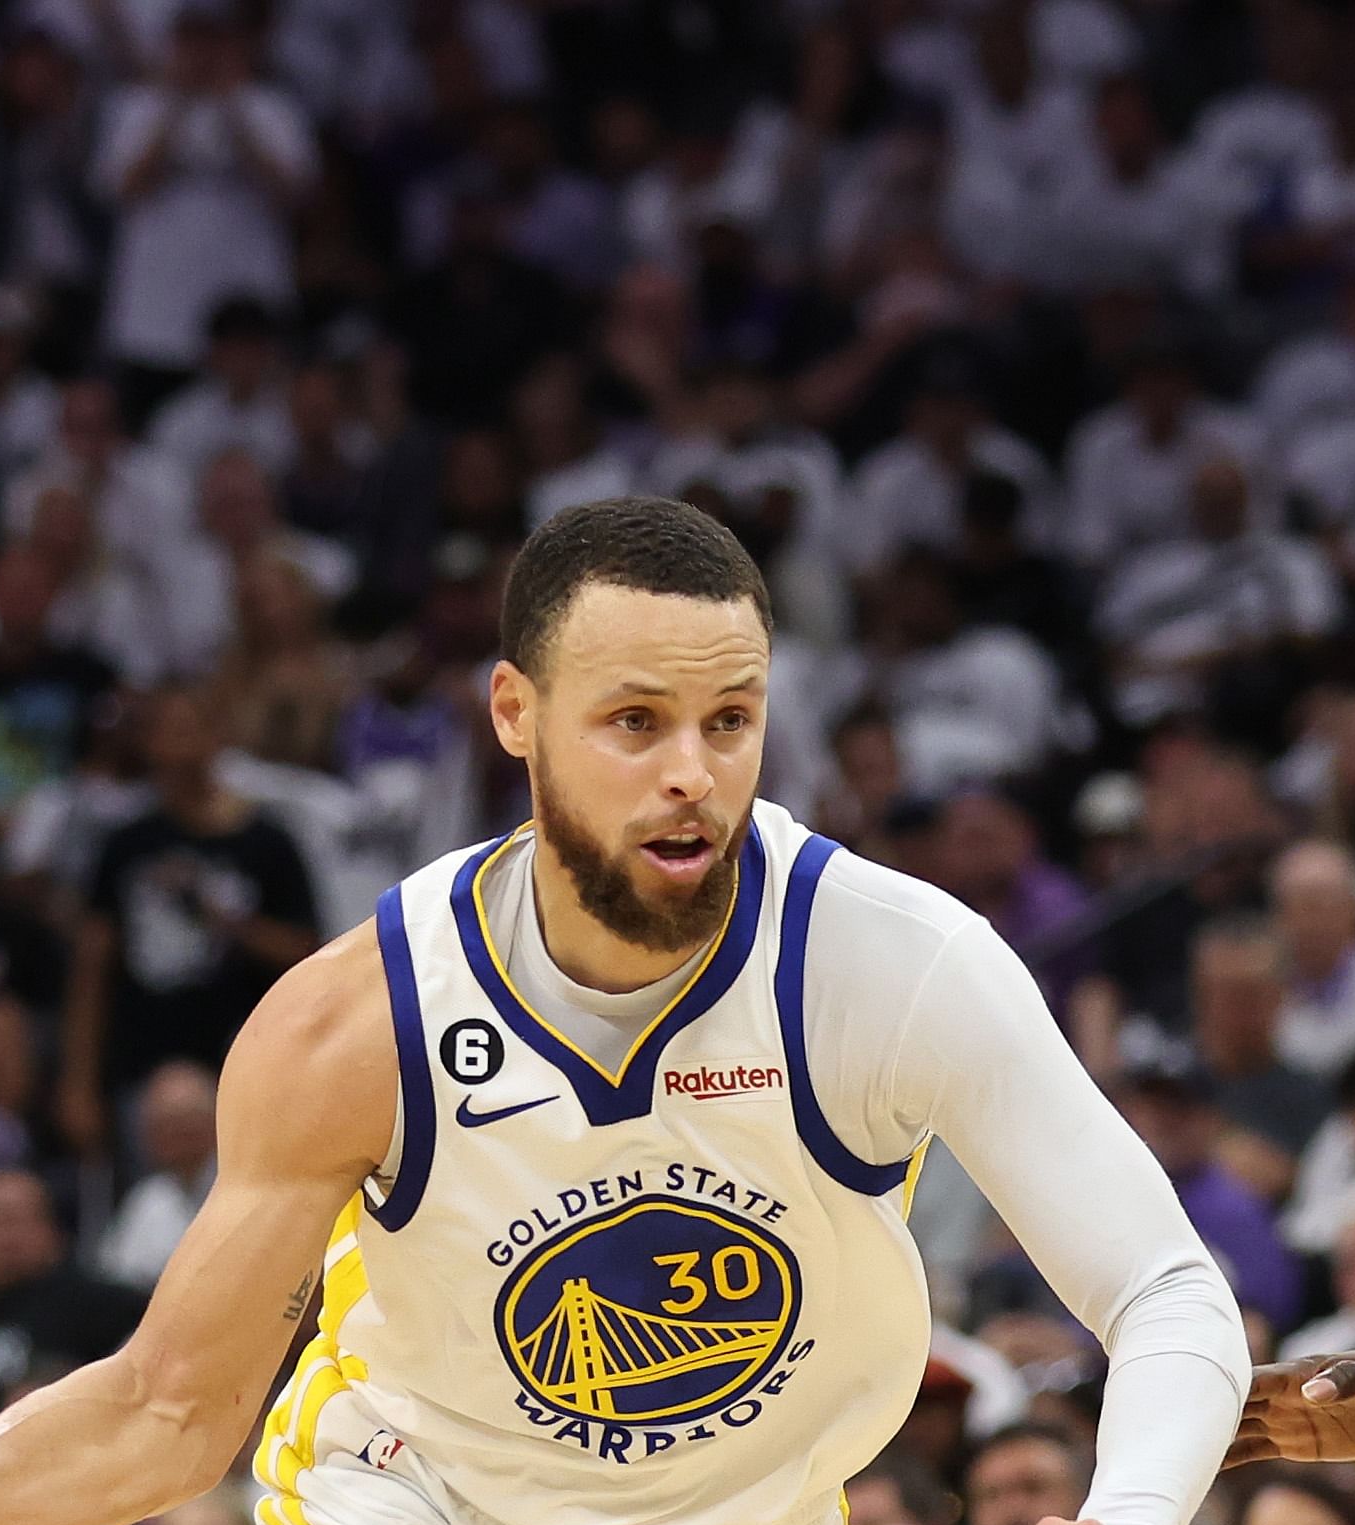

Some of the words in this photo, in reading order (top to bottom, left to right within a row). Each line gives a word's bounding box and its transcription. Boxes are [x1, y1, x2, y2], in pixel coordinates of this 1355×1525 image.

[455, 1028, 490, 1077] 6
[664, 1066, 784, 1096] Rakuten
[487, 1170, 643, 1266] GOLDEN
[666, 1163, 788, 1224] STATE
[652, 1245, 761, 1314] 30
[514, 1338, 815, 1464] WARRIORS
